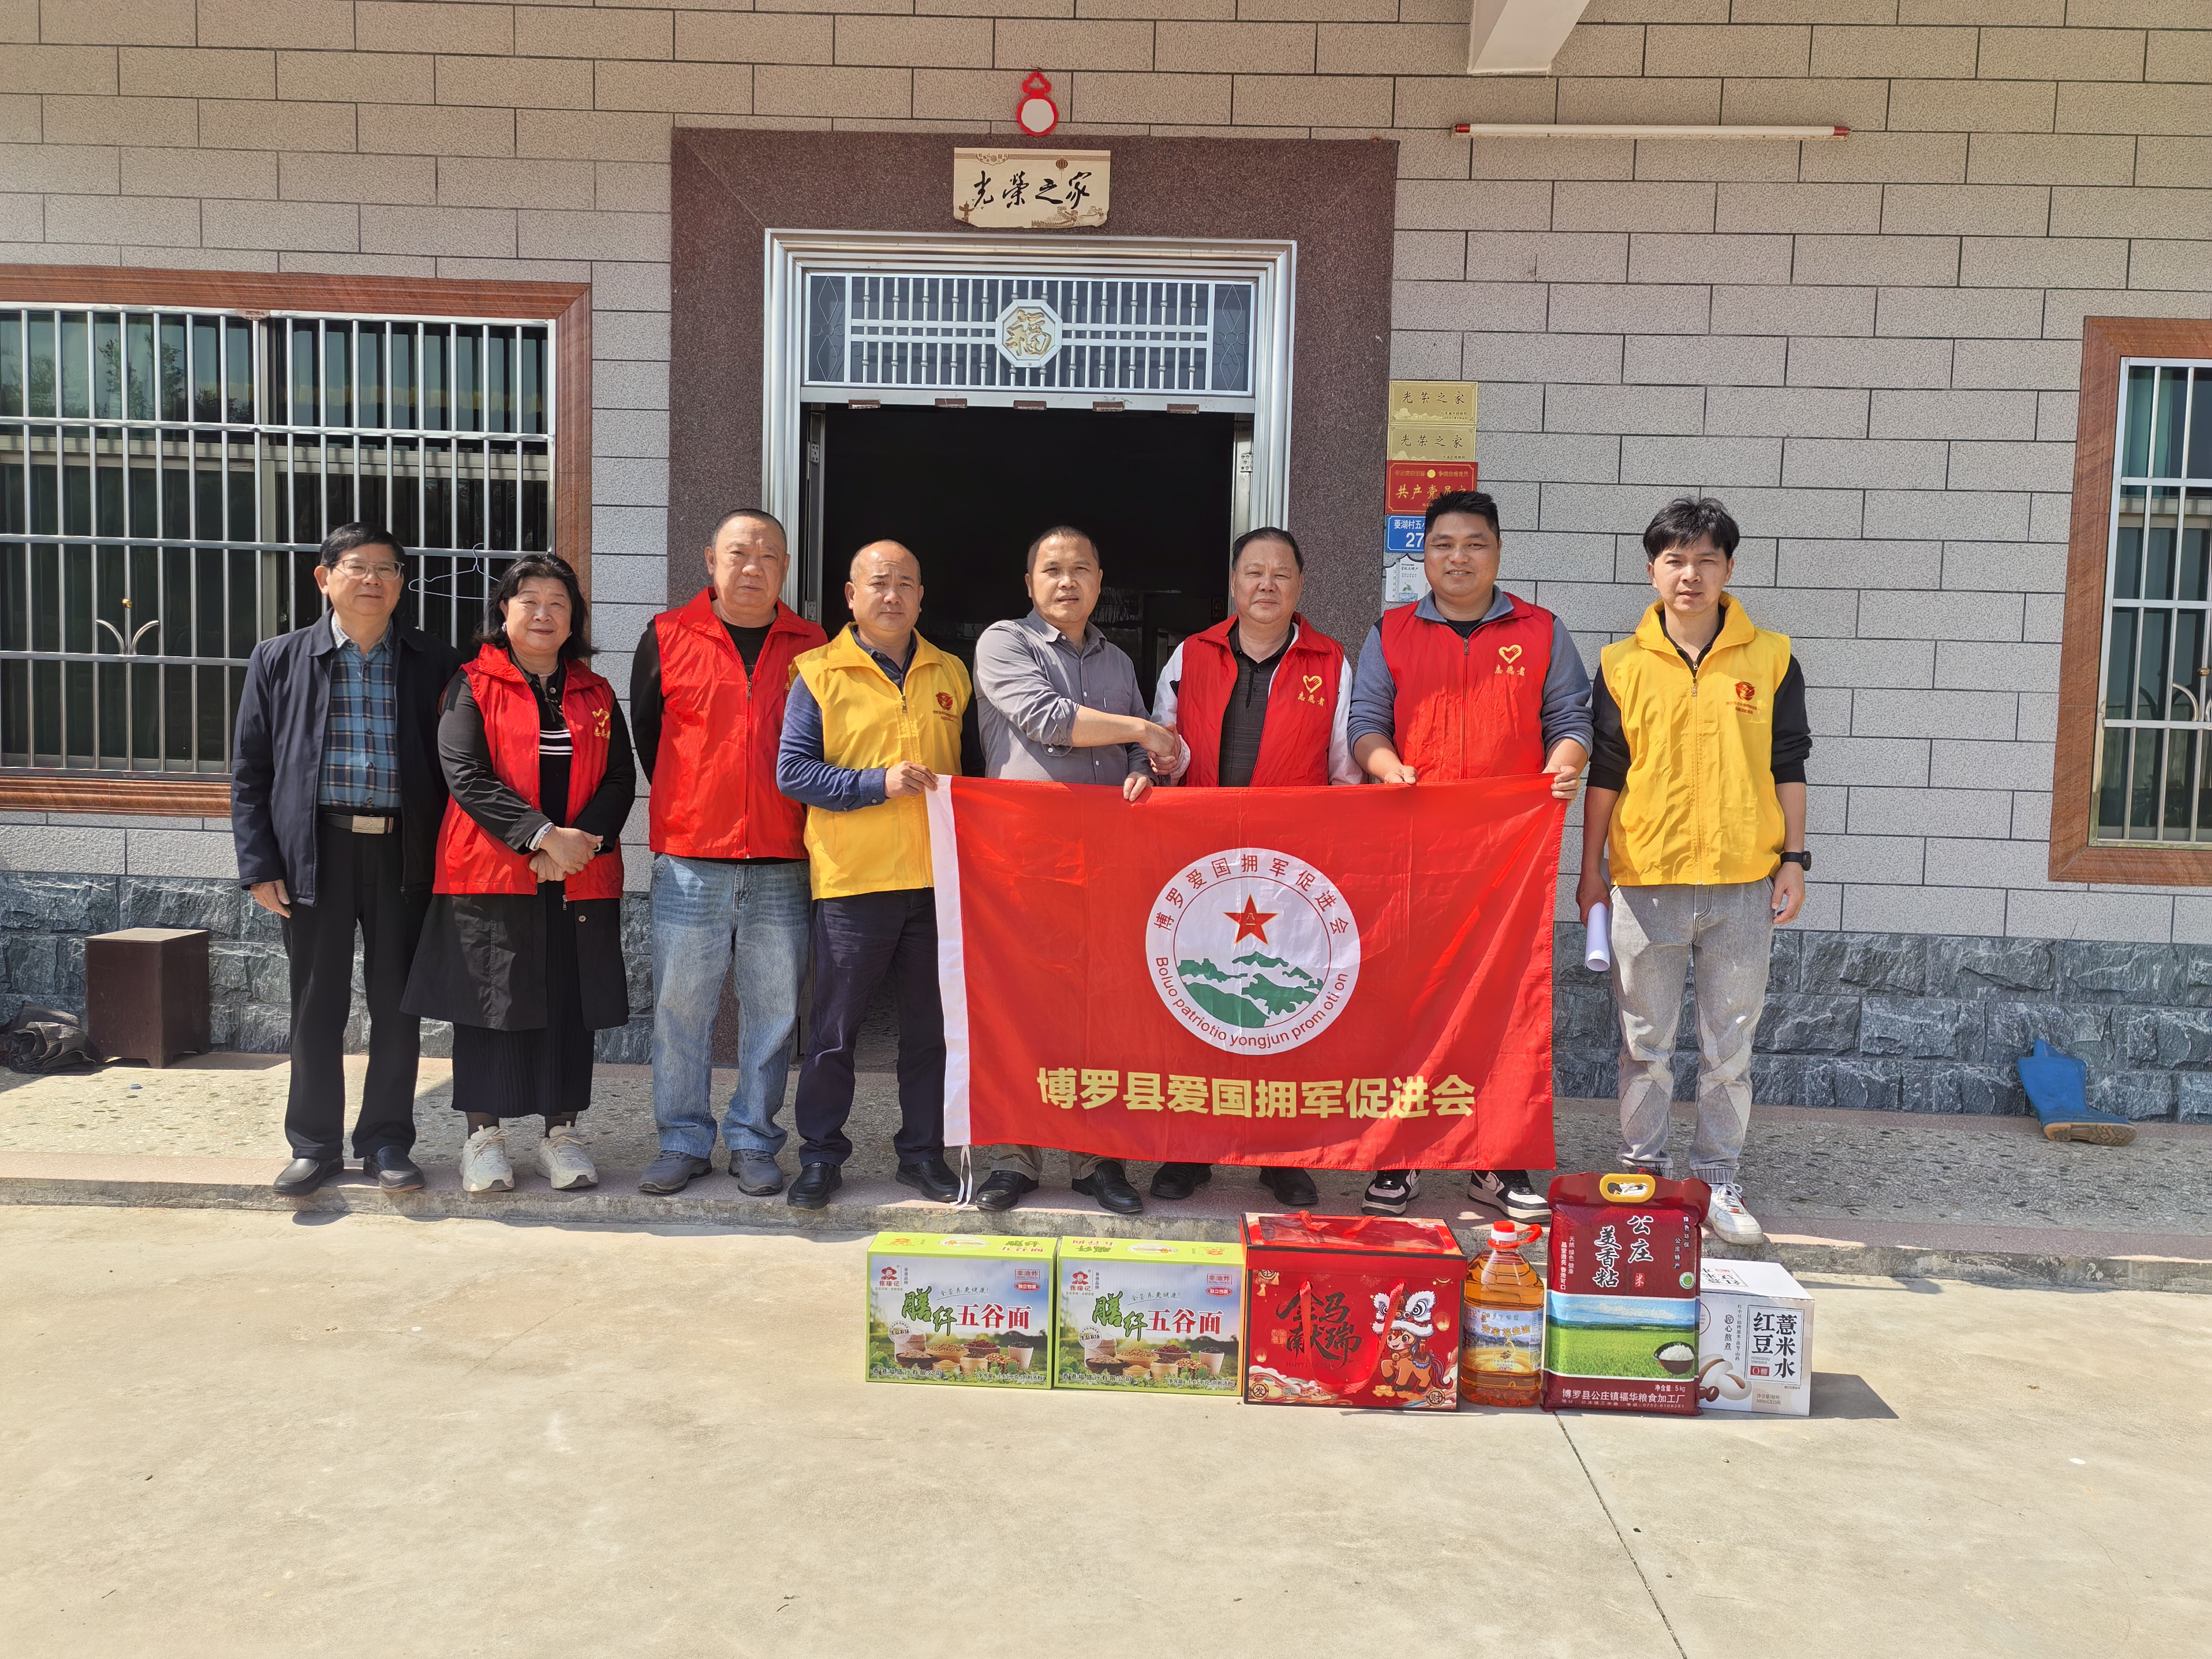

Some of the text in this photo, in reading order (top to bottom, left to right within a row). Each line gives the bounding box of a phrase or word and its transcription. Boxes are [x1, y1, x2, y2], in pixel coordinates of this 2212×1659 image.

[1005, 309, 1052, 356] 福
[1401, 390, 1465, 404] 光荣之家
[1401, 434, 1463, 448] 光荣之家
[1495, 664, 1525, 676] 志愿者
[1298, 691, 1325, 706] 志愿者
[1154, 854, 1349, 935] 博罗爱国拥军促进会
[1156, 957, 1178, 997] Boluo
[1230, 1033, 1290, 1049] yongjun
[1037, 1067, 1475, 1119] 博罗县爱国拥军促进会
[1593, 1225, 1622, 1287] 美香粘
[1627, 1216, 1654, 1263] 公庄
[955, 1303, 1032, 1330] 五谷面
[1146, 1307, 1224, 1335] 五谷面
[1751, 1312, 1775, 1353] 红豆
[1773, 1314, 1797, 1378] 薏米水
[1431, 1393, 1442, 1402] 财
[1562, 1388, 1685, 1404] 博罗县公庄镇福华粮食加工厂
